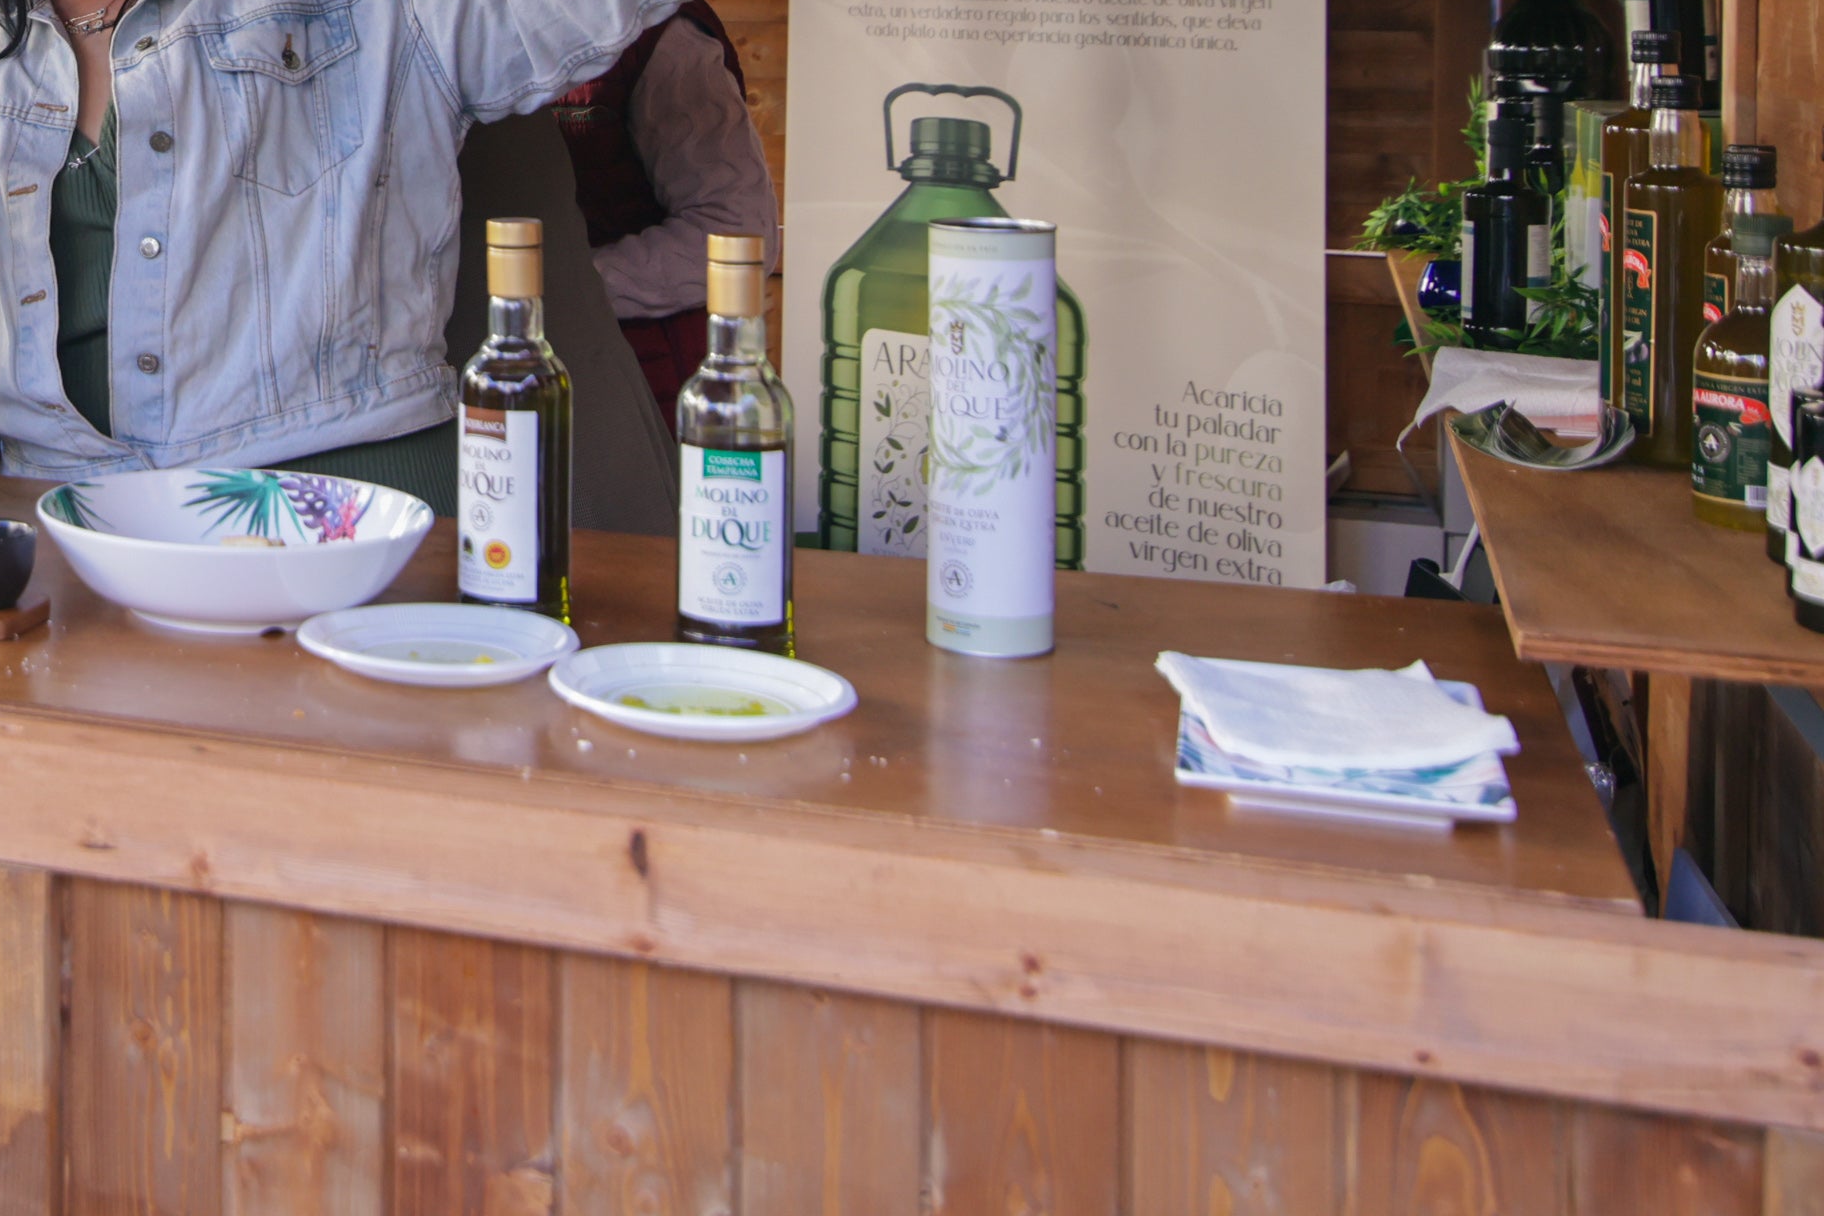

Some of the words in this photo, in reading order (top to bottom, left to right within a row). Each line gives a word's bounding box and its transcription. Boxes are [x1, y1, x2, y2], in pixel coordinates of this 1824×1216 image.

[865, 23, 900, 38] cada
[902, 24, 936, 42] plato
[938, 27, 949, 40] a
[951, 28, 980, 42] una
[983, 28, 1071, 47] experiencia
[1075, 30, 1186, 51] gastronómica
[1190, 34, 1239, 52] única.
[889, 5, 907, 19] un
[909, 5, 983, 22] verdadero
[986, 9, 1036, 27] regalo
[1039, 10, 1075, 28] para
[1078, 9, 1101, 27] los
[1181, 15, 1214, 33] que
[1216, 14, 1262, 32] eleva
[1182, 380, 1283, 418] Acaricia
[1701, 390, 1746, 412] AURORA
[1154, 403, 1179, 429] tu
[1186, 412, 1282, 445] paladar
[706, 464, 759, 477] TEMPRANA
[707, 455, 756, 467] COSECHA
[1113, 431, 1159, 454] con
[1166, 432, 1187, 457] la
[1194, 442, 1283, 474] pureza
[695, 485, 770, 505] MOLINO
[1150, 463, 1167, 489] y
[1176, 462, 1283, 503] frescura
[1148, 487, 1180, 512] de
[1187, 496, 1283, 530] nuestro
[692, 515, 774, 551] DUQUE
[1104, 511, 1180, 539] aceite
[1187, 520, 1219, 546] de
[1226, 528, 1283, 559] oliva
[1128, 541, 1209, 574] virgen
[1215, 557, 1283, 586] extra
